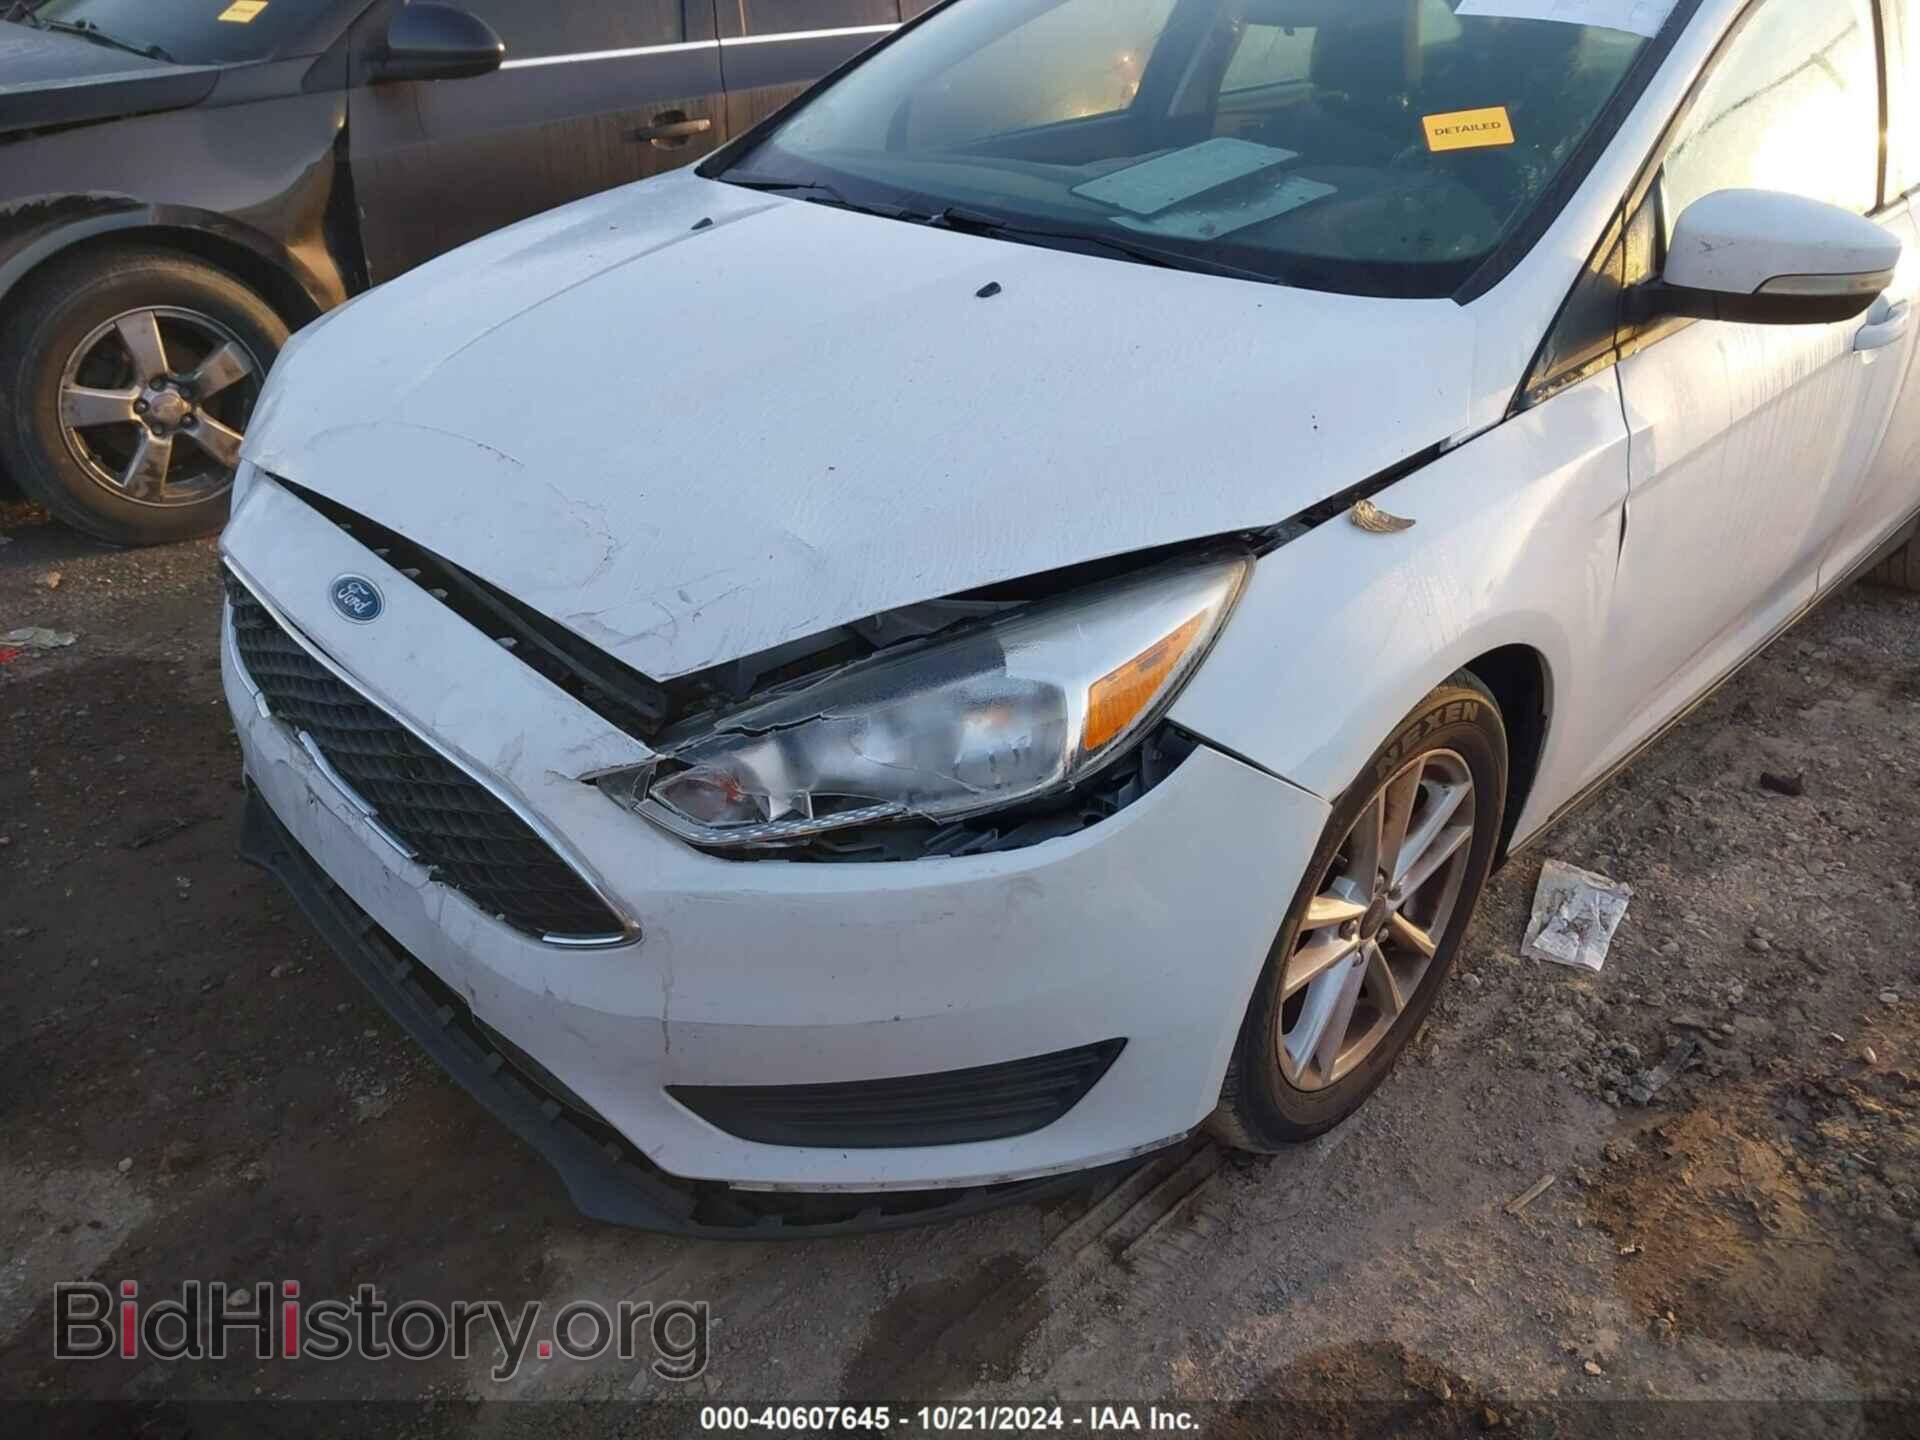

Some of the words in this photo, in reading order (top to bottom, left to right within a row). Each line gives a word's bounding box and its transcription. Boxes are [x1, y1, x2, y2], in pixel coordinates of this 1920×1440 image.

[1434, 121, 1502, 136] DETAILED
[338, 582, 372, 614] Ford
[1374, 700, 1480, 780] NEXEN
